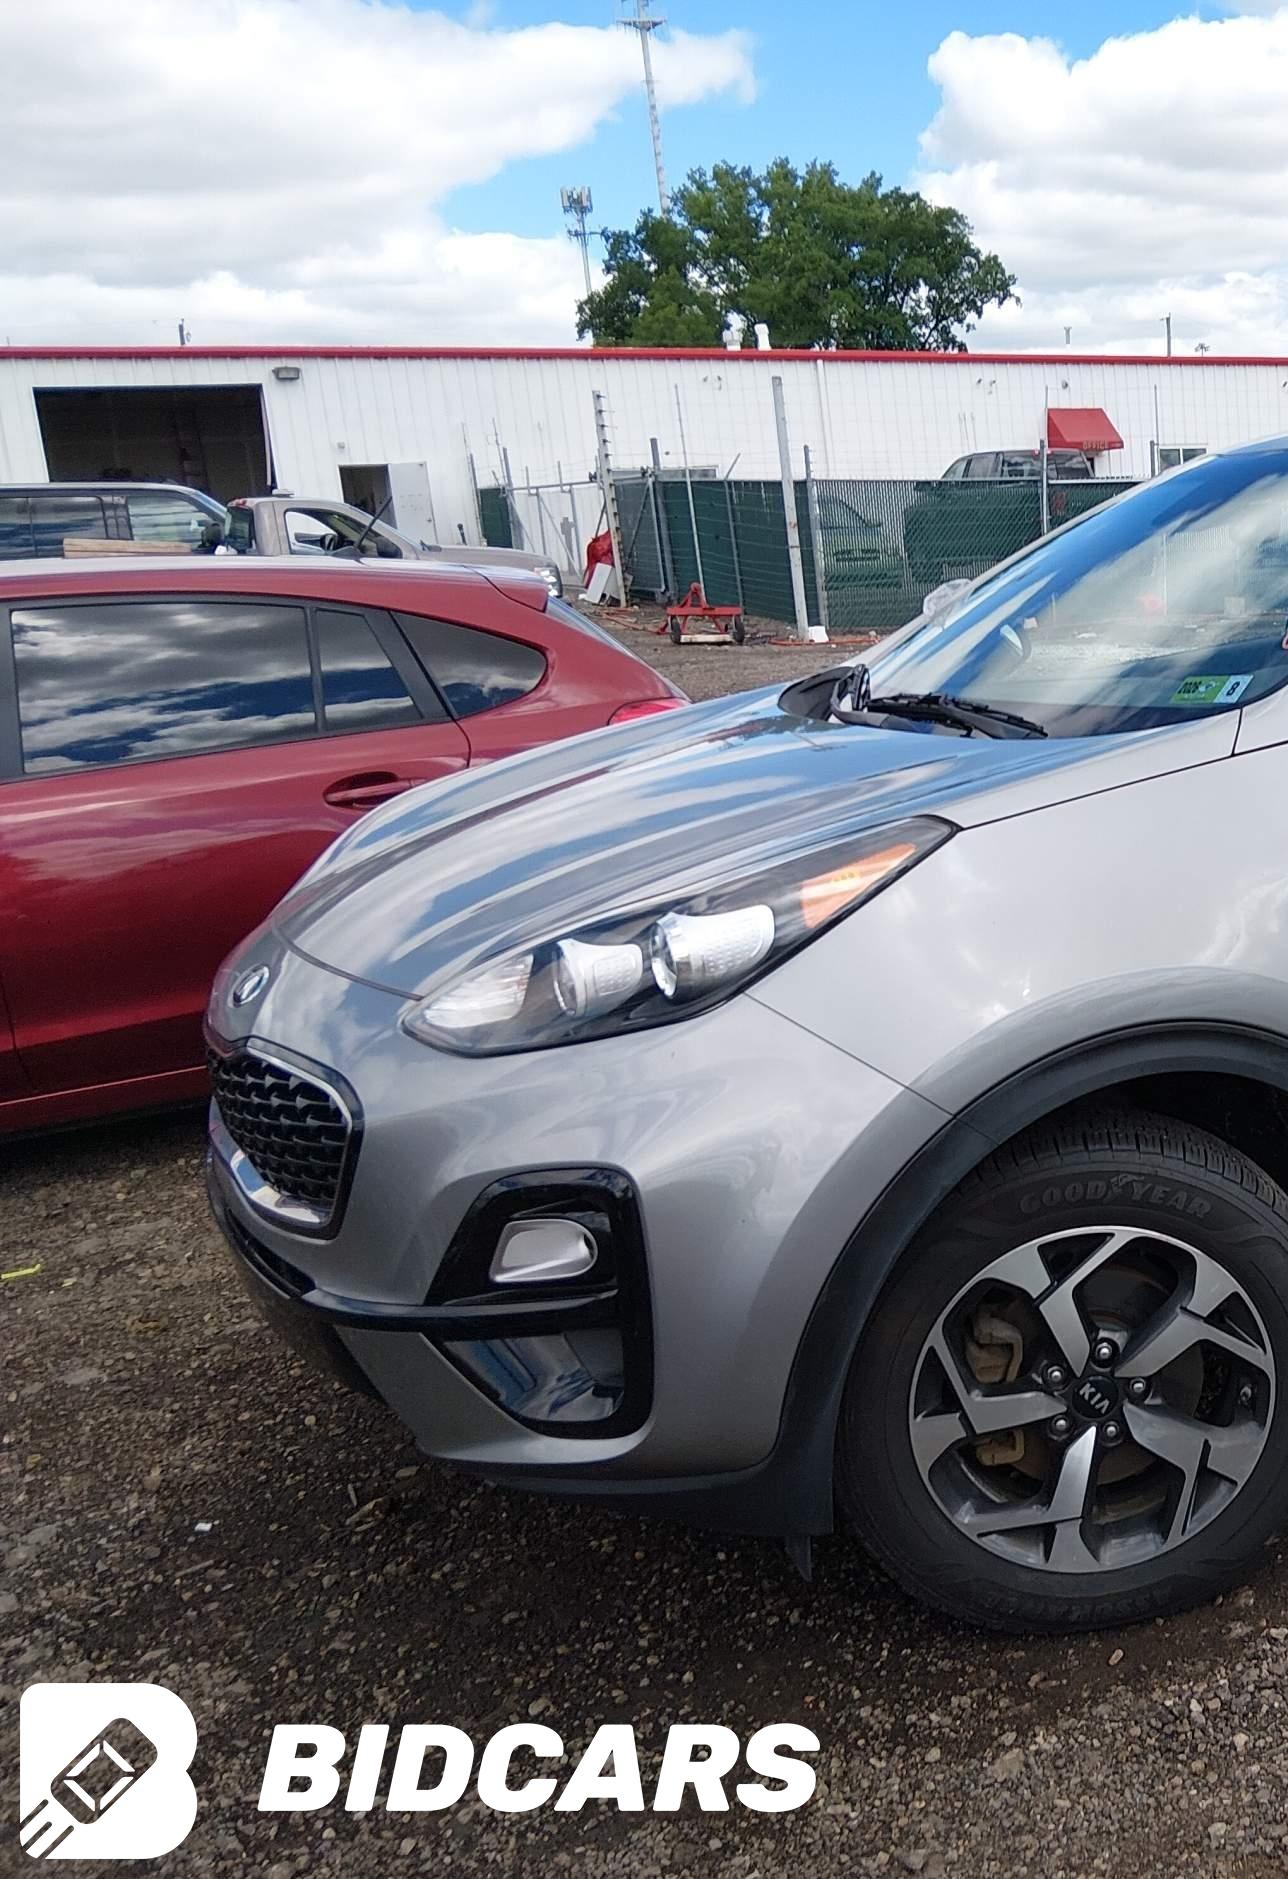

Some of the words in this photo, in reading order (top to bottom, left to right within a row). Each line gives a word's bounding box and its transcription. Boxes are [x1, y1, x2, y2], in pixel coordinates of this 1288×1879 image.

[1226, 681, 1241, 697] 8
[1018, 1177, 1212, 1217] GOODYEAR
[1080, 1382, 1110, 1414] KIA
